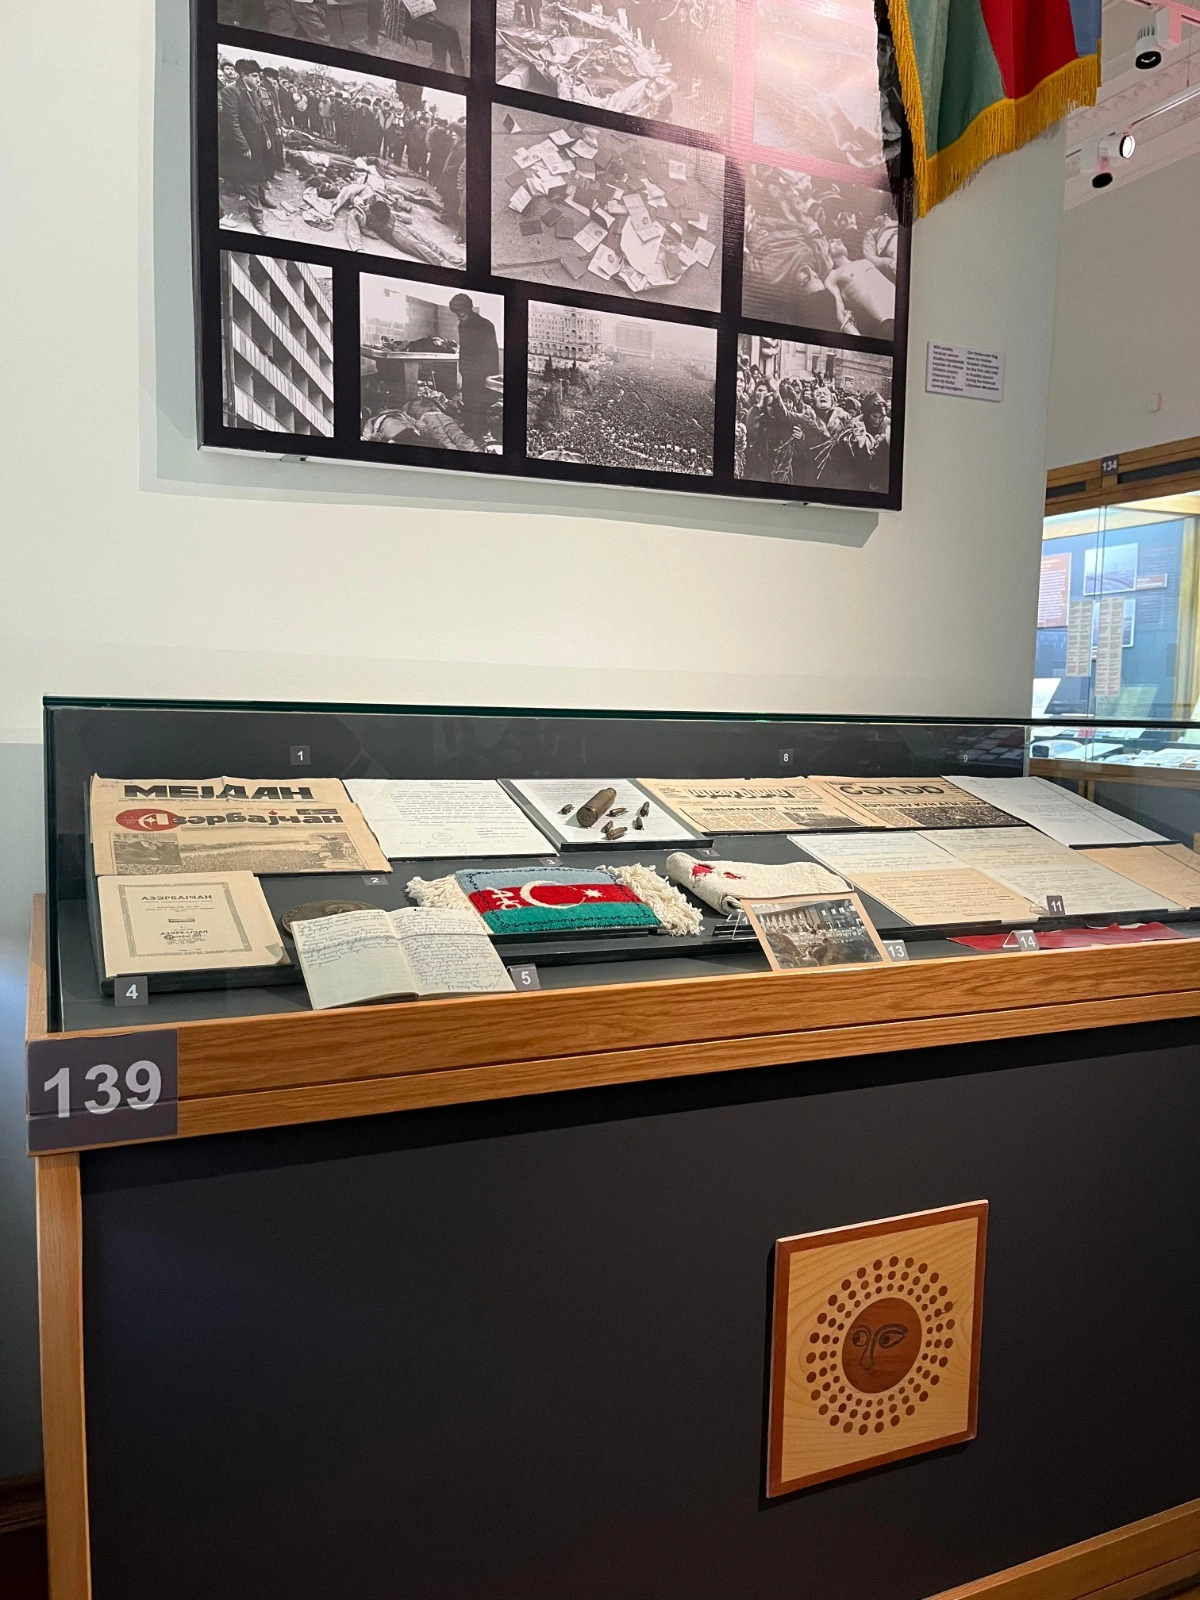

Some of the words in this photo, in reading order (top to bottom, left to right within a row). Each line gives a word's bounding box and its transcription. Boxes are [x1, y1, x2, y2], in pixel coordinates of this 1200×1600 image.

[1102, 460, 1118, 471] 134
[297, 750, 303, 761] 1
[783, 753, 789, 763] 8
[963, 754, 968, 763] 9
[1050, 901, 1063, 912] 11
[1020, 935, 1036, 948] 14
[888, 945, 905, 958] 13
[521, 972, 531, 985] 5
[125, 984, 138, 999] 4
[44, 1060, 162, 1118] 139
